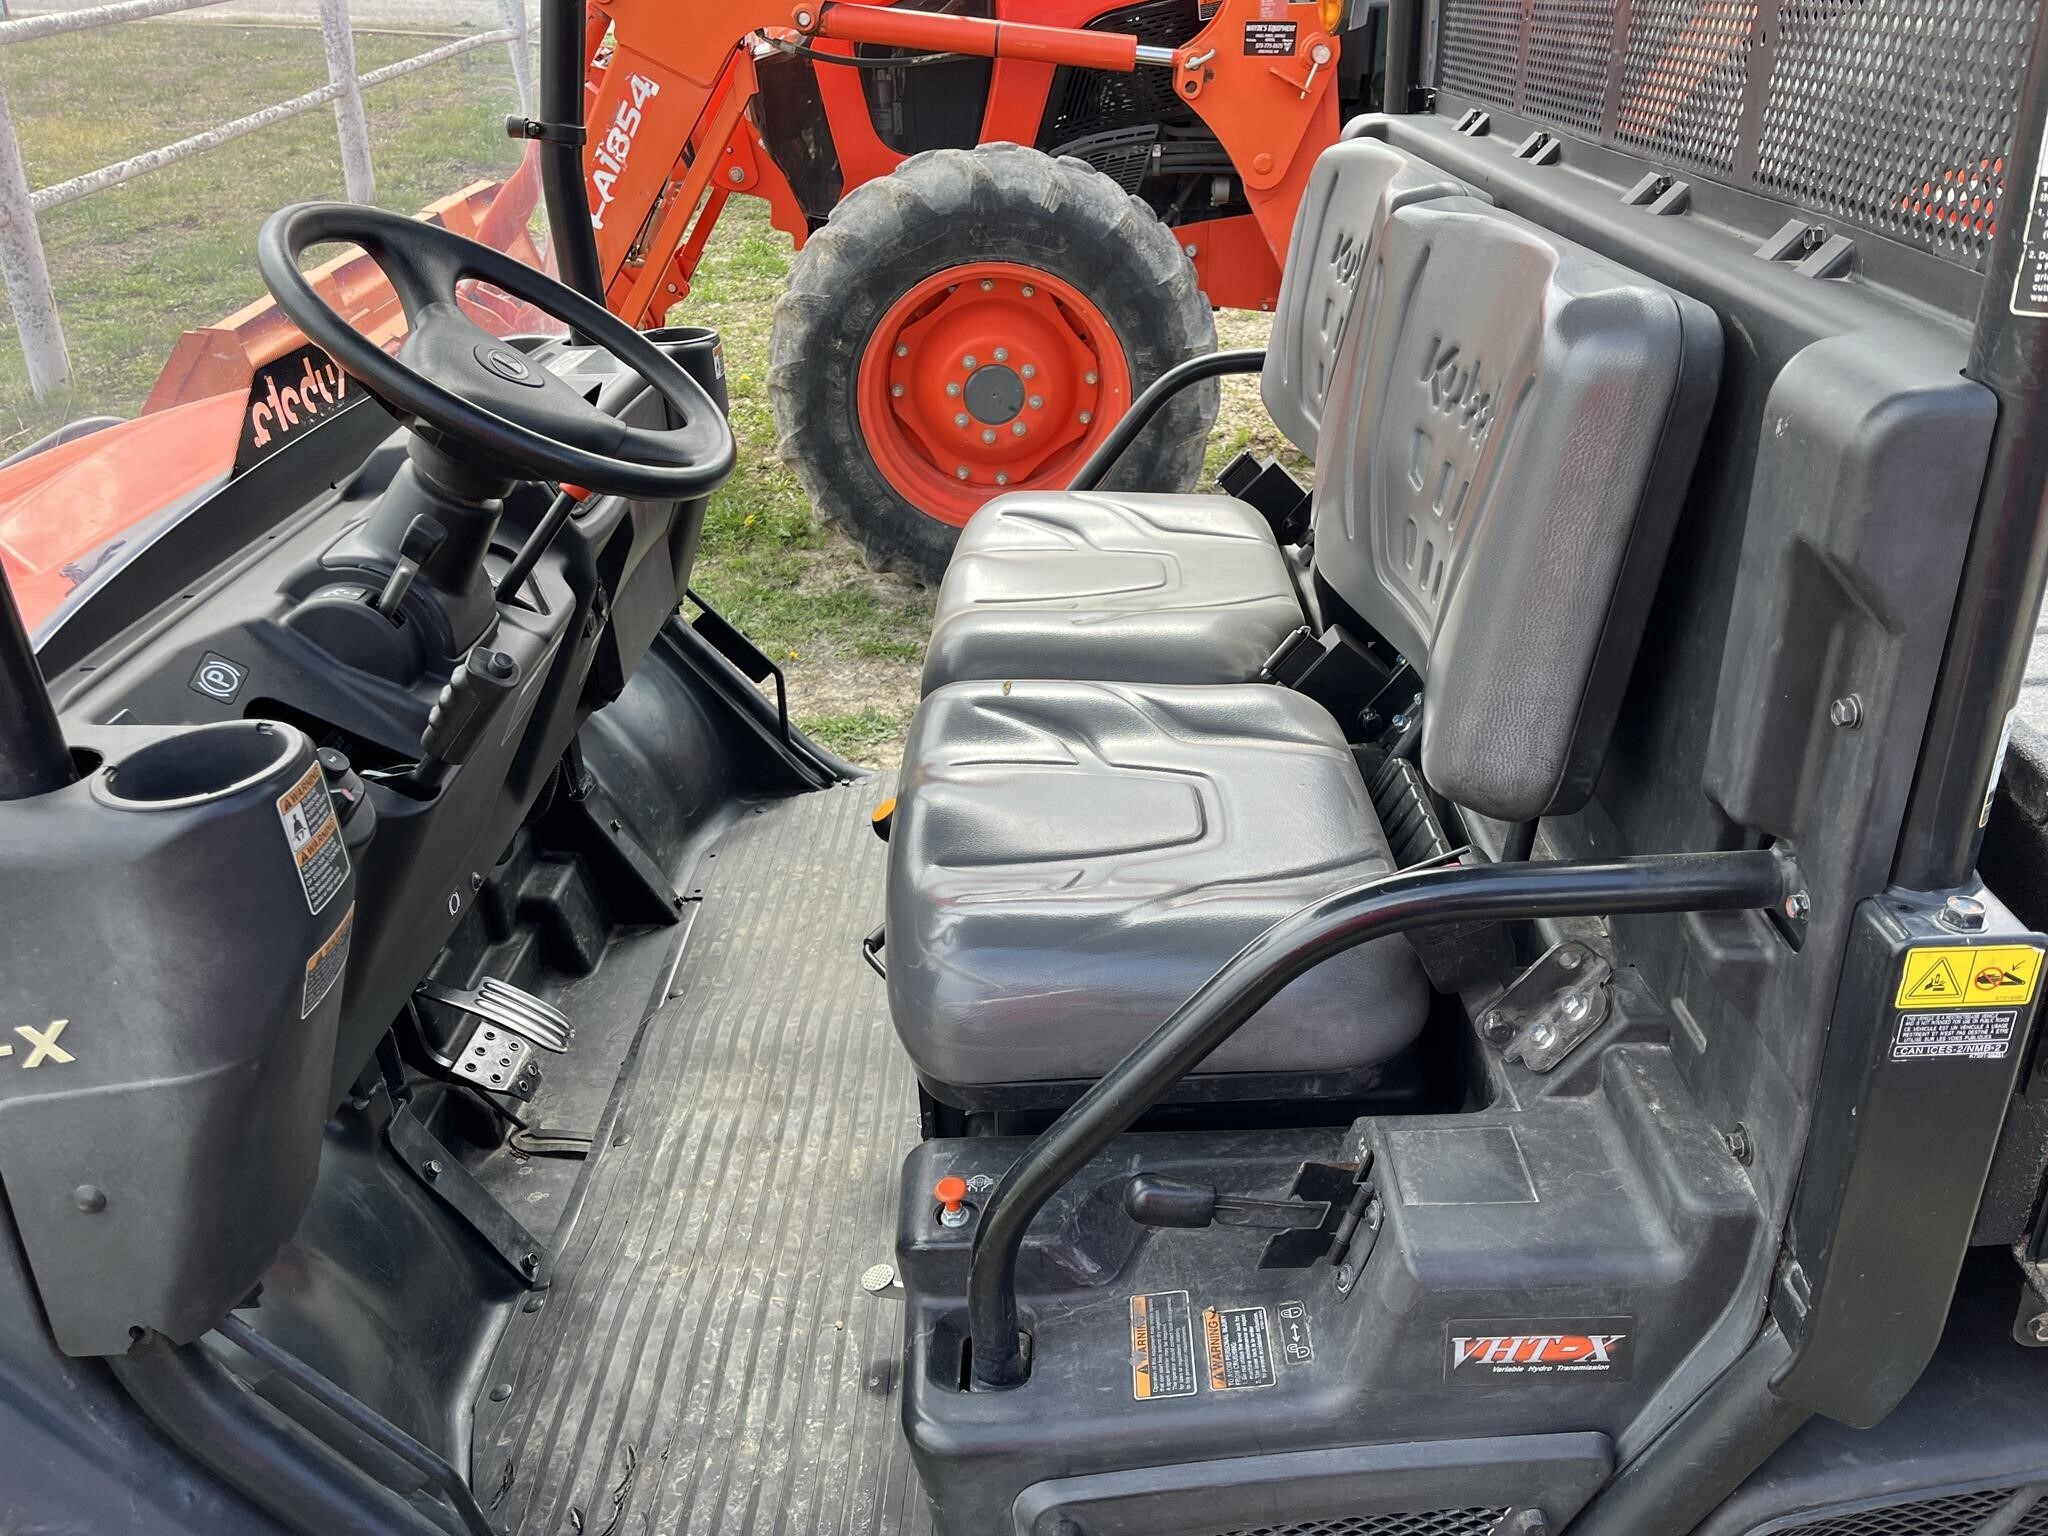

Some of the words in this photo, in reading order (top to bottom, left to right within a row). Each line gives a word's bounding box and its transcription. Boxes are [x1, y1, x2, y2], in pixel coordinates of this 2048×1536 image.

[592, 72, 660, 230] LA1854
[1208, 1321, 1222, 1369] WARNING
[1223, 1333, 1231, 1360] PERSONAL
[1452, 1335, 1627, 1370] VHT-X
[1557, 1364, 1610, 1372] Transmission
